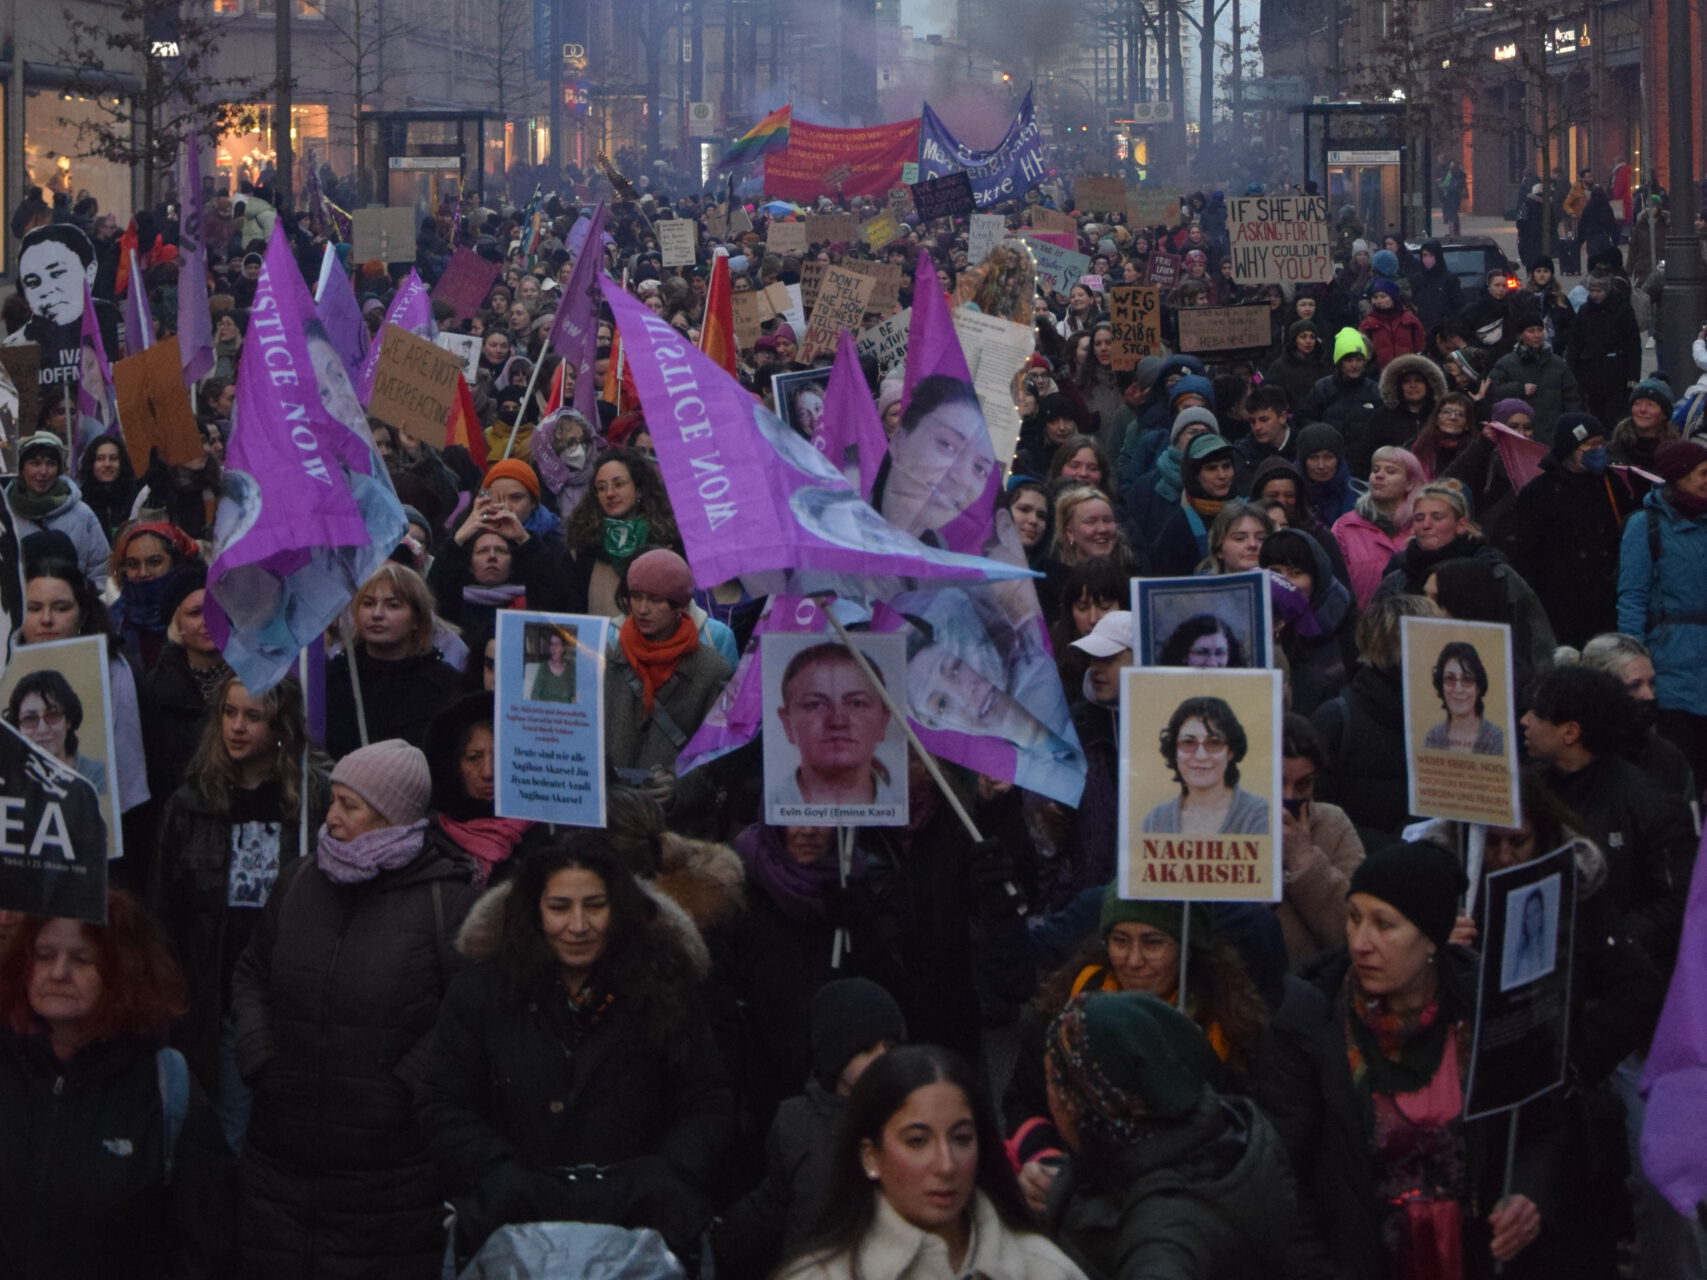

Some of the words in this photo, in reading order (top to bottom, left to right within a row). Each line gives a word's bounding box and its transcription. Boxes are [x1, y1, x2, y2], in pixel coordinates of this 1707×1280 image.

[1230, 200, 1251, 222] IF
[1256, 199, 1292, 222] SHE
[1295, 197, 1327, 222] WAS
[1236, 220, 1282, 241] ASKING
[1284, 221, 1308, 241] FOR
[1310, 221, 1323, 241] IT
[1234, 246, 1268, 278] WHY
[1272, 243, 1328, 258] COULDN'T
[1112, 290, 1155, 312] WEG
[382, 336, 406, 365] WE
[404, 343, 432, 377] ARE
[431, 357, 460, 388] NOT
[280, 400, 334, 488] NOW
[514, 747, 537, 758] Heute
[538, 749, 554, 760] sind
[556, 751, 569, 761] wir
[571, 752, 586, 762] alle
[512, 760, 543, 773] Nagihan
[545, 763, 574, 776] Akarsel
[576, 766, 589, 777] Jin
[532, 776, 566, 788] bedeutet
[568, 781, 591, 792] Azadi
[519, 789, 549, 802] Nagihan
[551, 793, 583, 804] Akarsel
[868, 807, 895, 818] Kara)
[1143, 840, 1260, 860] NAGIHAN
[1142, 863, 1262, 884] AKARSEL
